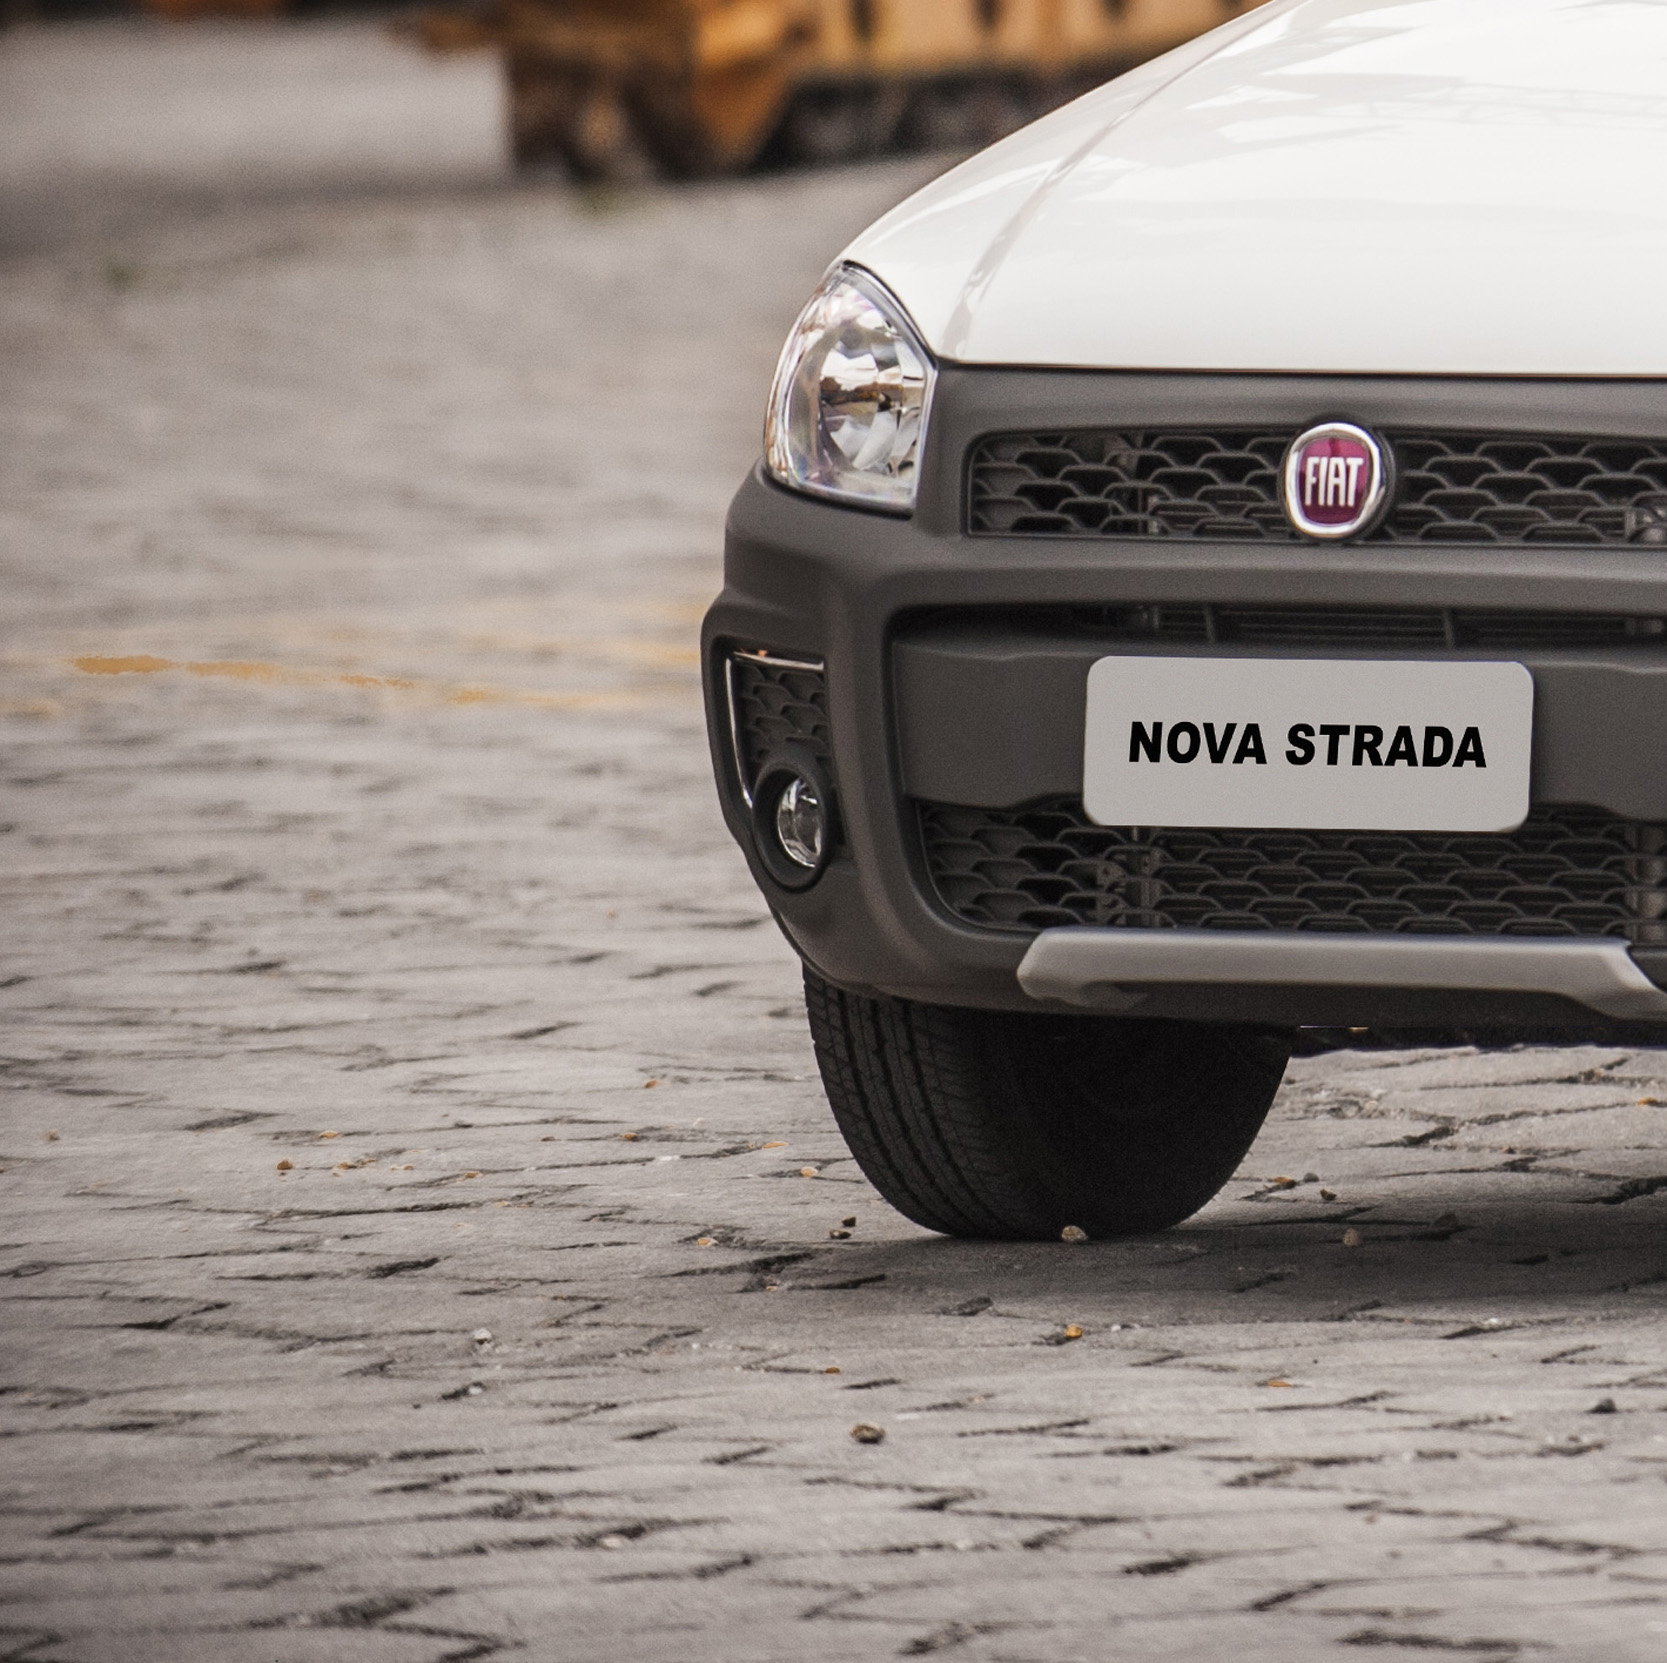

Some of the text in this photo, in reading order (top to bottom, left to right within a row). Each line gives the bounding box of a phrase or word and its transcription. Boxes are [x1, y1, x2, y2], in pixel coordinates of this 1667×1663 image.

[1304, 456, 1365, 507] FIAT
[1128, 721, 1487, 769] NOVA STRADA
